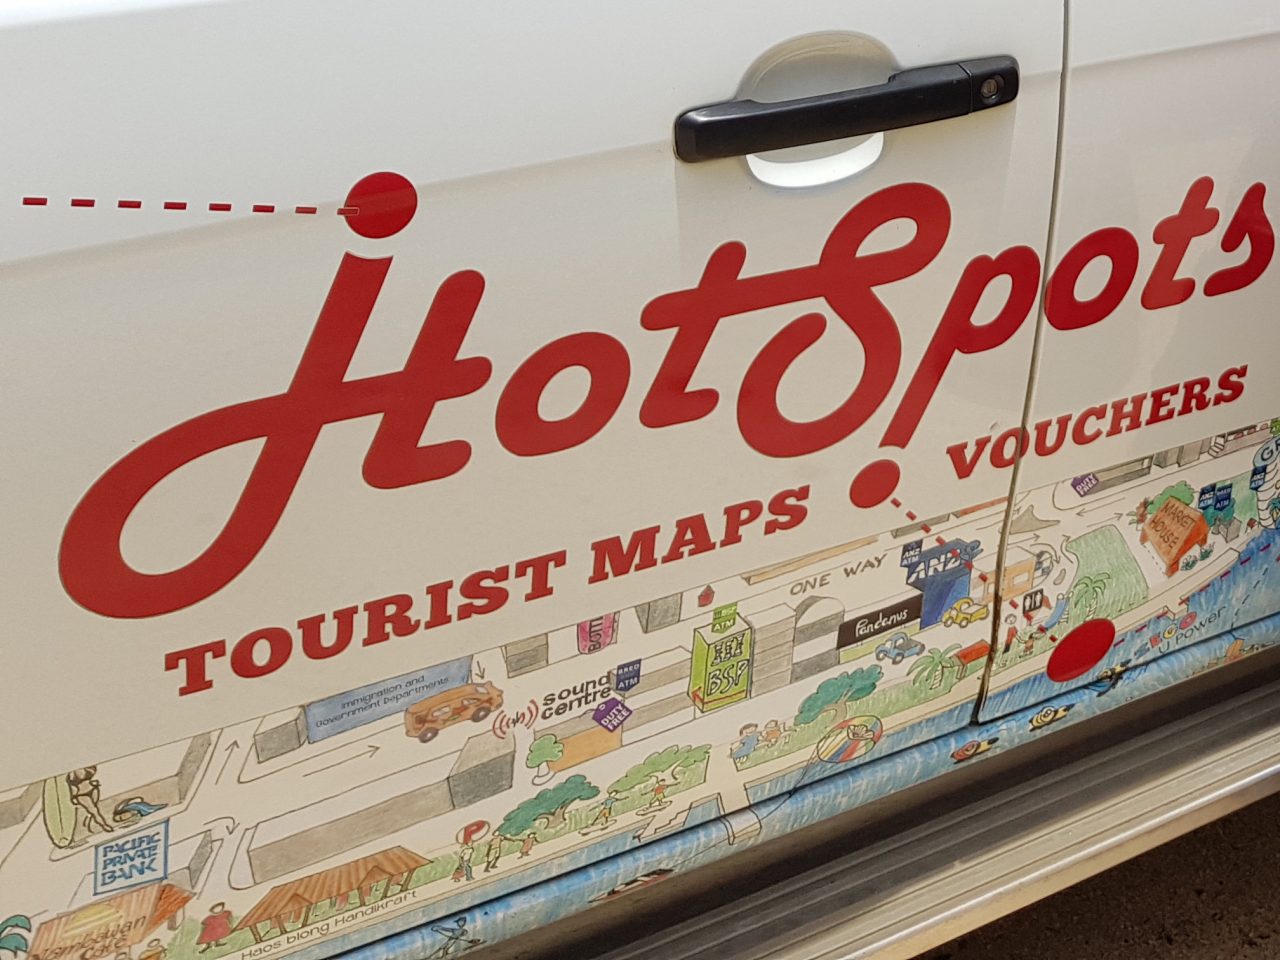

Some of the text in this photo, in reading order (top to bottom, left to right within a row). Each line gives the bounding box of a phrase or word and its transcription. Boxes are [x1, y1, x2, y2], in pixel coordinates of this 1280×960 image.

[58, 172, 1276, 619] HotSpots
[945, 364, 1249, 480] VOUCHERS
[1075, 473, 1095, 492] DUTY
[1080, 478, 1098, 497] FREE
[1160, 501, 1197, 530] MARKET
[1149, 517, 1180, 549] HOUSE
[901, 556, 919, 566] ATM
[902, 548, 921, 558] ANZ
[907, 548, 961, 584] ANZ
[789, 553, 888, 596] ONE WAY
[164, 484, 811, 697] TOURIST MAPS
[713, 619, 734, 632] ATM
[855, 609, 908, 637] Pandanus
[1175, 606, 1226, 645] Power
[340, 674, 425, 710] Immigration and
[542, 672, 611, 706] sound
[617, 677, 638, 690] ATM
[706, 658, 750, 697] BSP
[315, 676, 449, 728] Government Departments
[541, 685, 611, 720] centre
[600, 704, 624, 727] DUTY
[606, 710, 631, 733] FREE
[102, 831, 162, 858] PACIFIC
[102, 844, 158, 871] PRIVATE
[100, 857, 157, 887] BANK
[240, 889, 418, 960] Haos blong Handikraft
